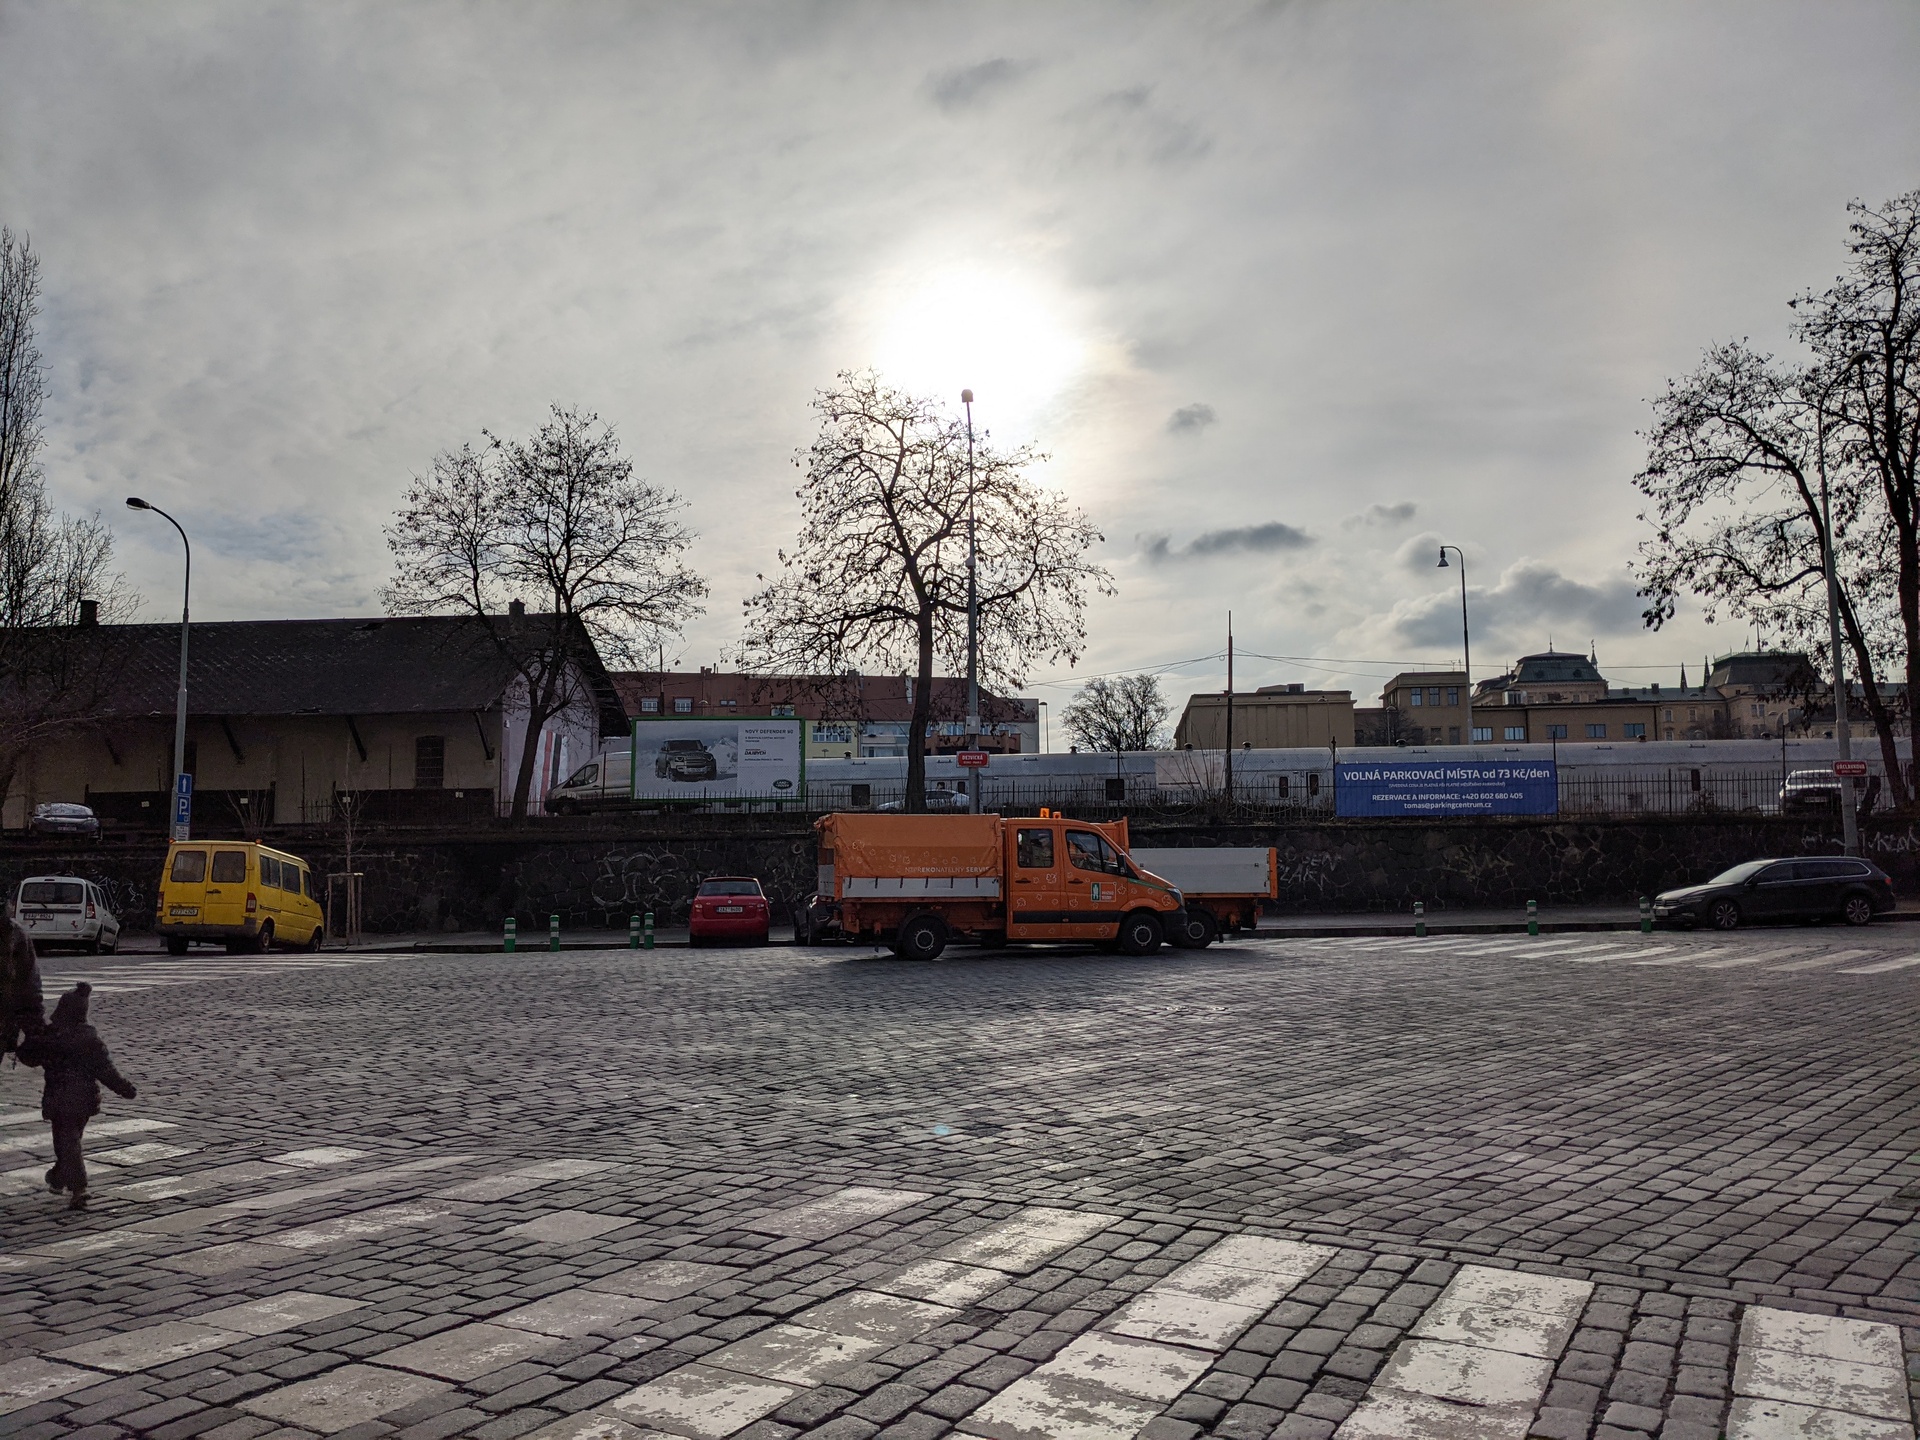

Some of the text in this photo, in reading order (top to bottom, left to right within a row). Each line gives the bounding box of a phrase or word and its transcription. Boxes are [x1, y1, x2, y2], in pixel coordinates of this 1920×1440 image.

[1343, 767, 1550, 781] VOLNÁ PARKOVACÍ MÍSTA od 73 Kč/den
[1404, 801, 1492, 810] tomas@parkingcentrum.cz
